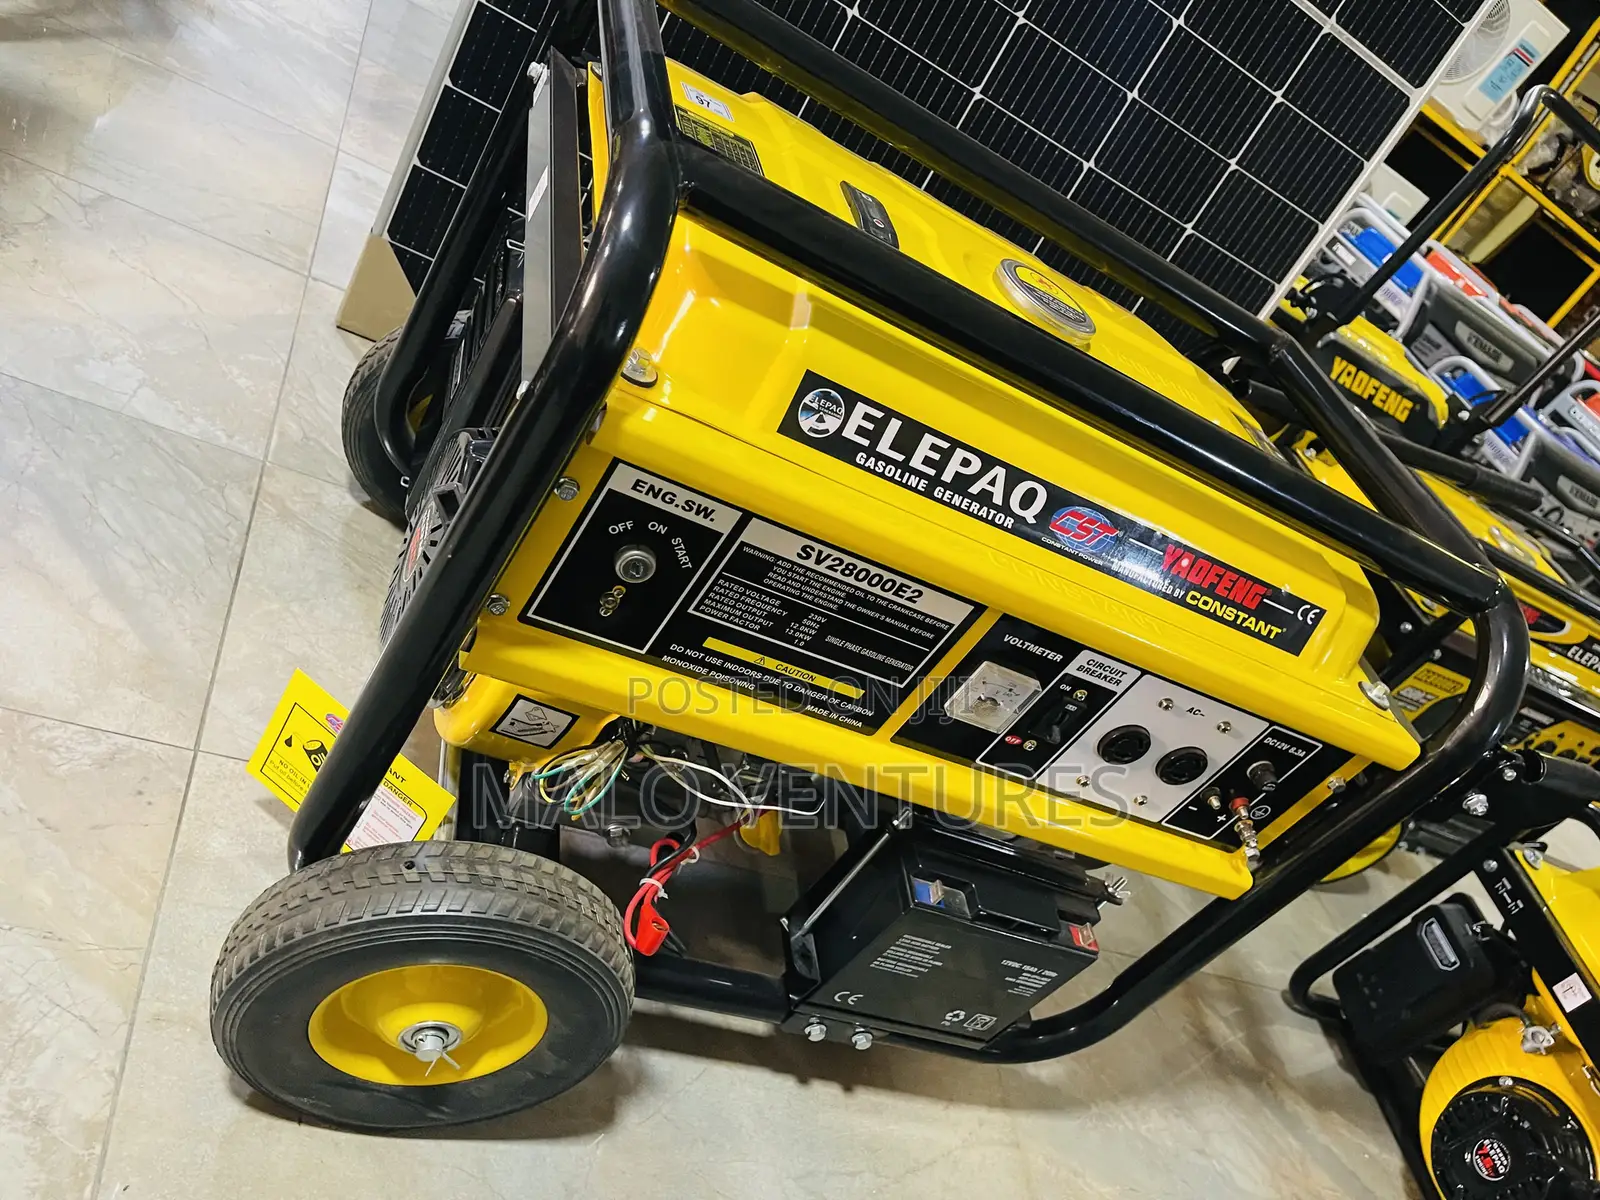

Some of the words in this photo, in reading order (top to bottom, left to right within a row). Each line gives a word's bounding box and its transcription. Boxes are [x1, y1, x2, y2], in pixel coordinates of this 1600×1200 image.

[810, 394, 843, 415] ELEPAQ
[1328, 356, 1415, 423] YAOFENG
[841, 401, 1048, 524] ELEPAQ
[630, 478, 716, 522] ENG.SW.
[855, 451, 929, 492] GASOLINE
[933, 486, 1015, 529] GENERATOR
[607, 520, 635, 535] OFF
[647, 521, 668, 535] ON
[1049, 512, 1119, 546] CST
[671, 536, 693, 570] START
[1041, 536, 1079, 556] CONSTANT
[1078, 552, 1104, 566] POWER
[742, 546, 777, 564] WARNING:
[776, 560, 791, 569] ADD
[792, 565, 806, 575] THE
[805, 569, 854, 593] RECOMMENDED
[855, 590, 866, 599] OIL
[866, 594, 876, 602] TO
[876, 598, 888, 607] THE
[888, 603, 925, 621] CRANKCASE
[924, 615, 950, 631] BEFORE
[763, 578, 800, 597] OPERATING
[800, 592, 814, 602] THE
[773, 565, 787, 575] YOU
[787, 571, 808, 583] START
[809, 579, 822, 589] THE
[796, 544, 924, 604] SV28000E2
[1111, 560, 1177, 595] MANUFACTURED
[1173, 588, 1186, 599] BY
[1161, 543, 1268, 610] YAOFENG
[708, 592, 735, 606] RATED
[735, 601, 768, 618] OUTPUT
[790, 622, 818, 636] 12.0KW
[713, 585, 740, 599] RATED
[740, 595, 788, 617] FREQUENCY
[801, 618, 820, 629] 50Hz
[717, 579, 745, 593] RATED
[745, 589, 782, 607] VOLTAGE
[808, 613, 828, 623] 230V
[767, 572, 786, 583] READ
[786, 578, 801, 589] AND
[800, 583, 843, 605] UNDERSTAND
[844, 601, 856, 610] THE
[885, 616, 910, 631] MANUAL
[909, 626, 935, 640] BEFORE
[1185, 590, 1282, 640] CONSTANT
[699, 605, 729, 620] POWER
[729, 616, 761, 631] FACTOR
[793, 639, 805, 647] 1.0
[703, 598, 741, 616] MAXIMUM
[741, 611, 774, 628] OUTPUT
[784, 628, 812, 642] 13.0KW
[825, 635, 845, 647] SINGLE
[844, 641, 861, 653] PHASE
[860, 647, 886, 663] GASOLINE
[884, 656, 914, 672] GENERATOR
[1003, 634, 1064, 663] VOLTMETER
[661, 655, 709, 676] MONOXIDE
[708, 670, 756, 691] POISONING
[669, 644, 686, 654] DO
[687, 649, 705, 661] NOT
[704, 655, 723, 667] USE
[723, 660, 763, 680] INDOORS
[763, 675, 781, 686] DUE
[781, 680, 794, 690] TO
[793, 684, 828, 702] DANGER
[828, 695, 841, 705] OF
[840, 700, 875, 717] CARBON
[775, 663, 817, 683] CAUTION
[1076, 664, 1122, 687] BREAKER
[1086, 658, 1128, 678] CIRCUIT
[1060, 684, 1072, 692] ON
[805, 704, 829, 718] MADE
[829, 711, 838, 720] IN
[837, 715, 863, 728] CHINA
[1005, 735, 1021, 745] OFF
[1263, 737, 1291, 751] DC12V
[279, 760, 289, 769] NO
[289, 769, 298, 778] OIL
[383, 781, 413, 807] DANGER
